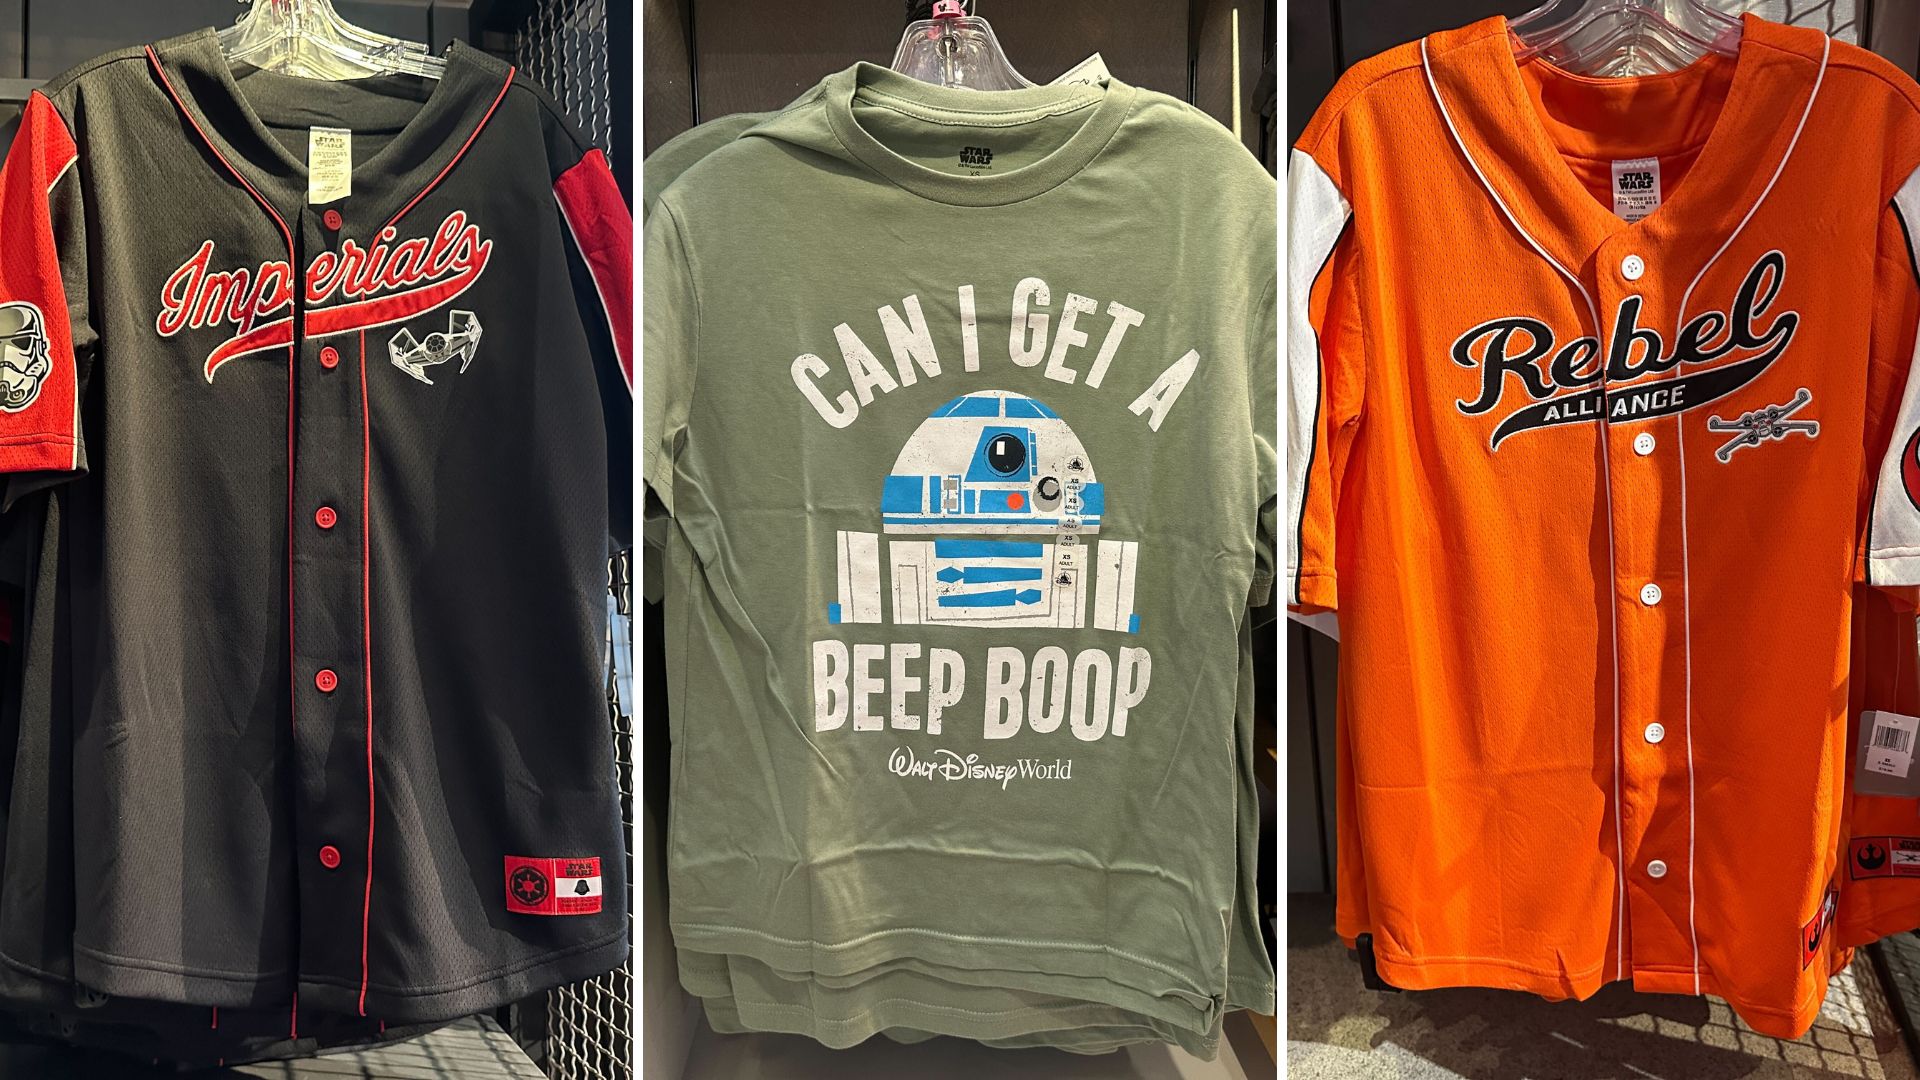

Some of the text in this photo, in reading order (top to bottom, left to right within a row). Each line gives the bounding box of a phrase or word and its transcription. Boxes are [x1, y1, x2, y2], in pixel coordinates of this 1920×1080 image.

[960, 146, 993, 157] STAR
[960, 154, 993, 164] WARS
[1619, 172, 1653, 181] STAR
[1619, 179, 1653, 190] WARS
[156, 210, 493, 338] Imperials
[1451, 249, 1799, 416] Rebel
[791, 276, 1200, 432] CAN I GET A
[1543, 384, 1685, 421] ALLIANCE
[812, 639, 1152, 742] BEEP BOOP
[1016, 758, 1072, 780] World
